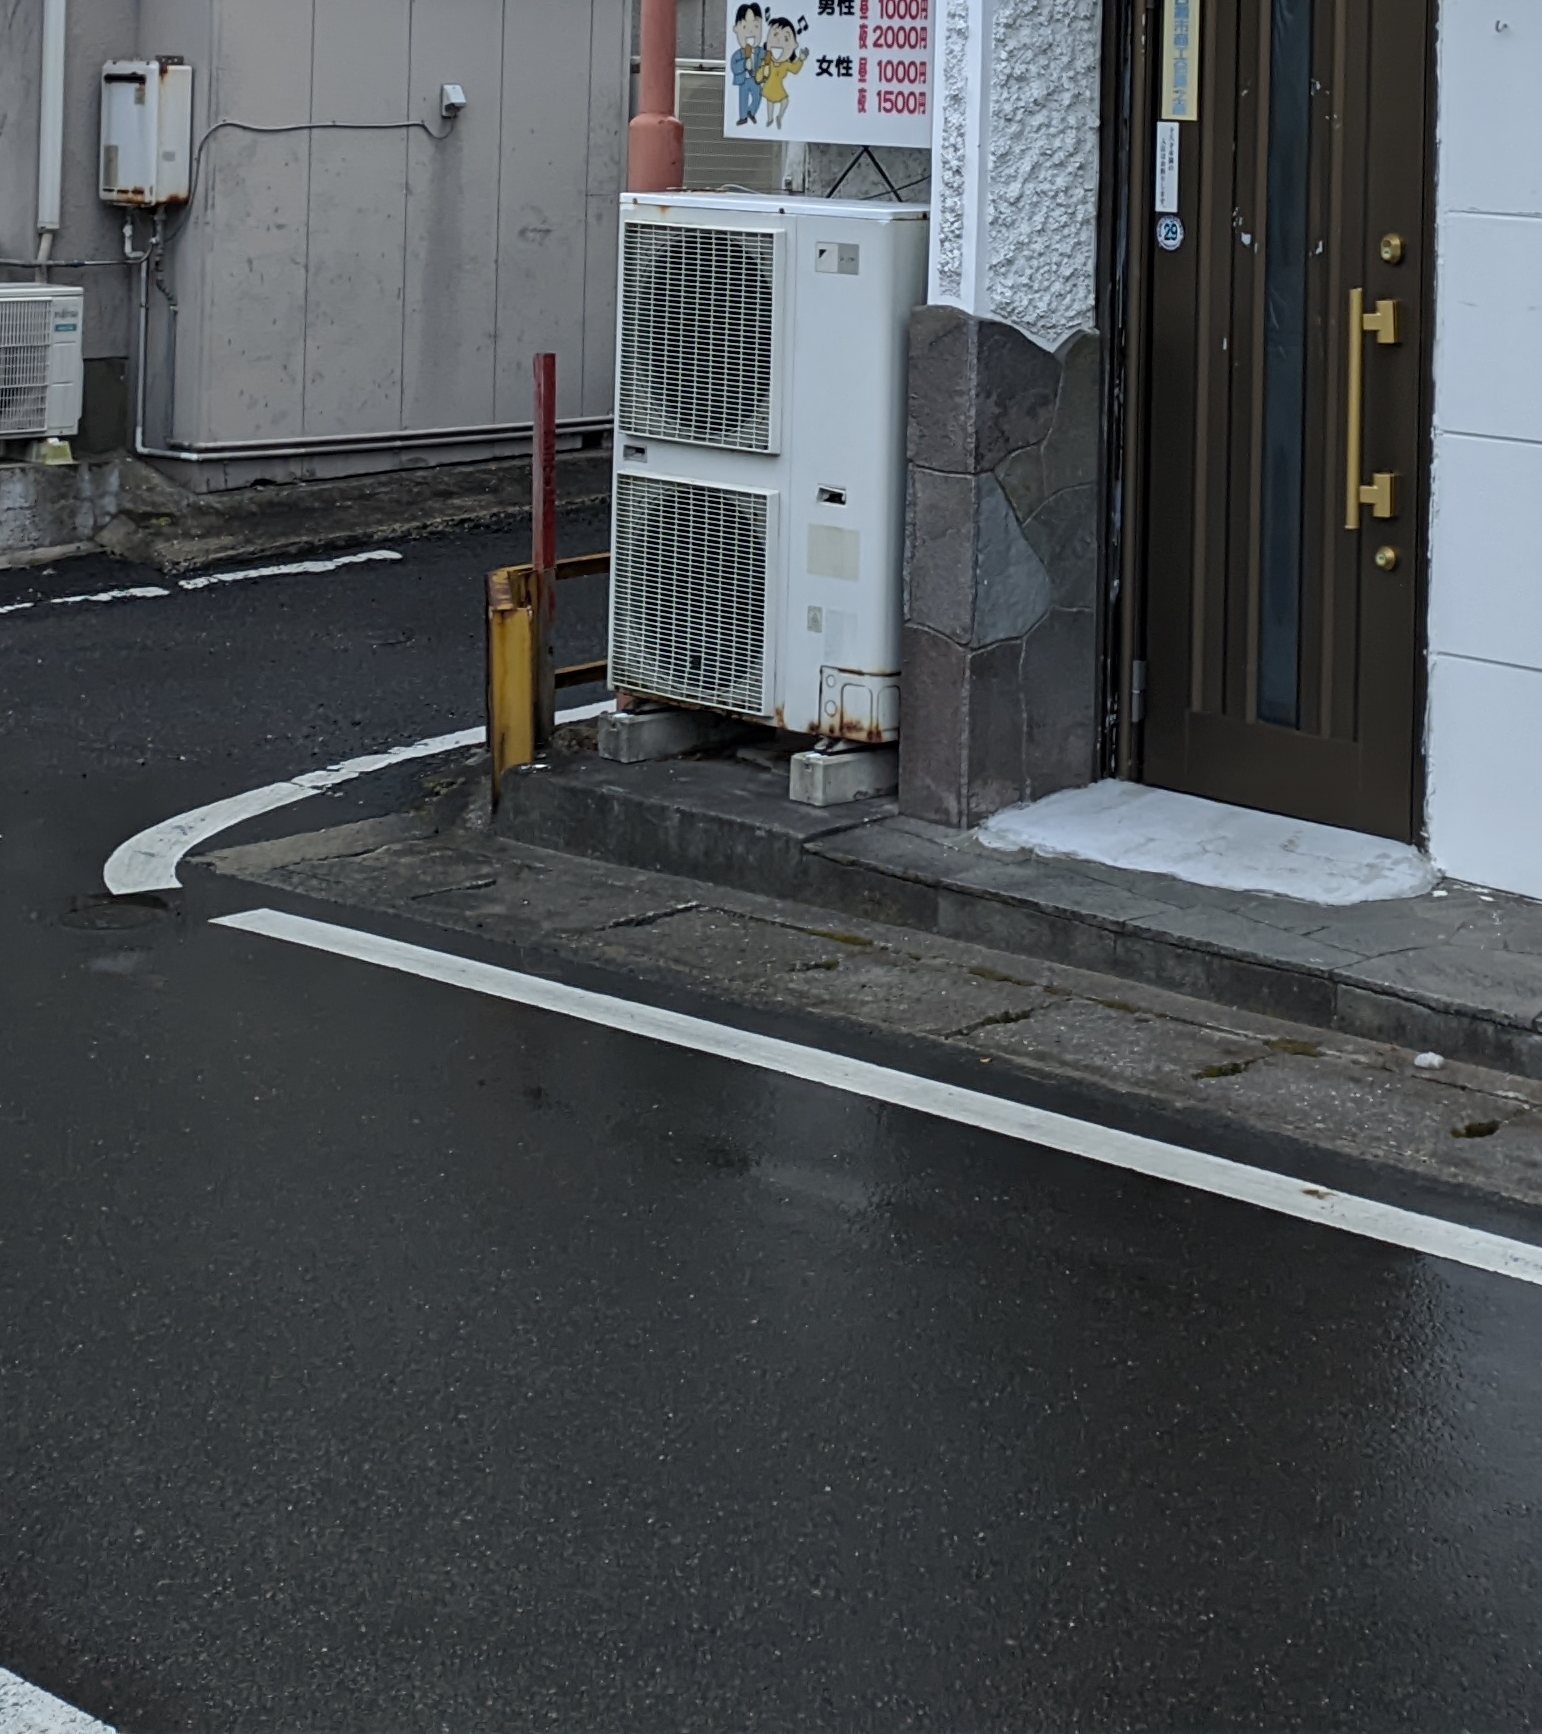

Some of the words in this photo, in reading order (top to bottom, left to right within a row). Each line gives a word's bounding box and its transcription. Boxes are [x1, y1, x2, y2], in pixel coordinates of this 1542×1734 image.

[872, 25, 927, 50] 2000円
[815, 54, 854, 79] 女性
[858, 57, 867, 83] 昼
[877, 59, 927, 84] 1000円
[876, 90, 926, 115] 1500円
[1163, 223, 1178, 241] 29
